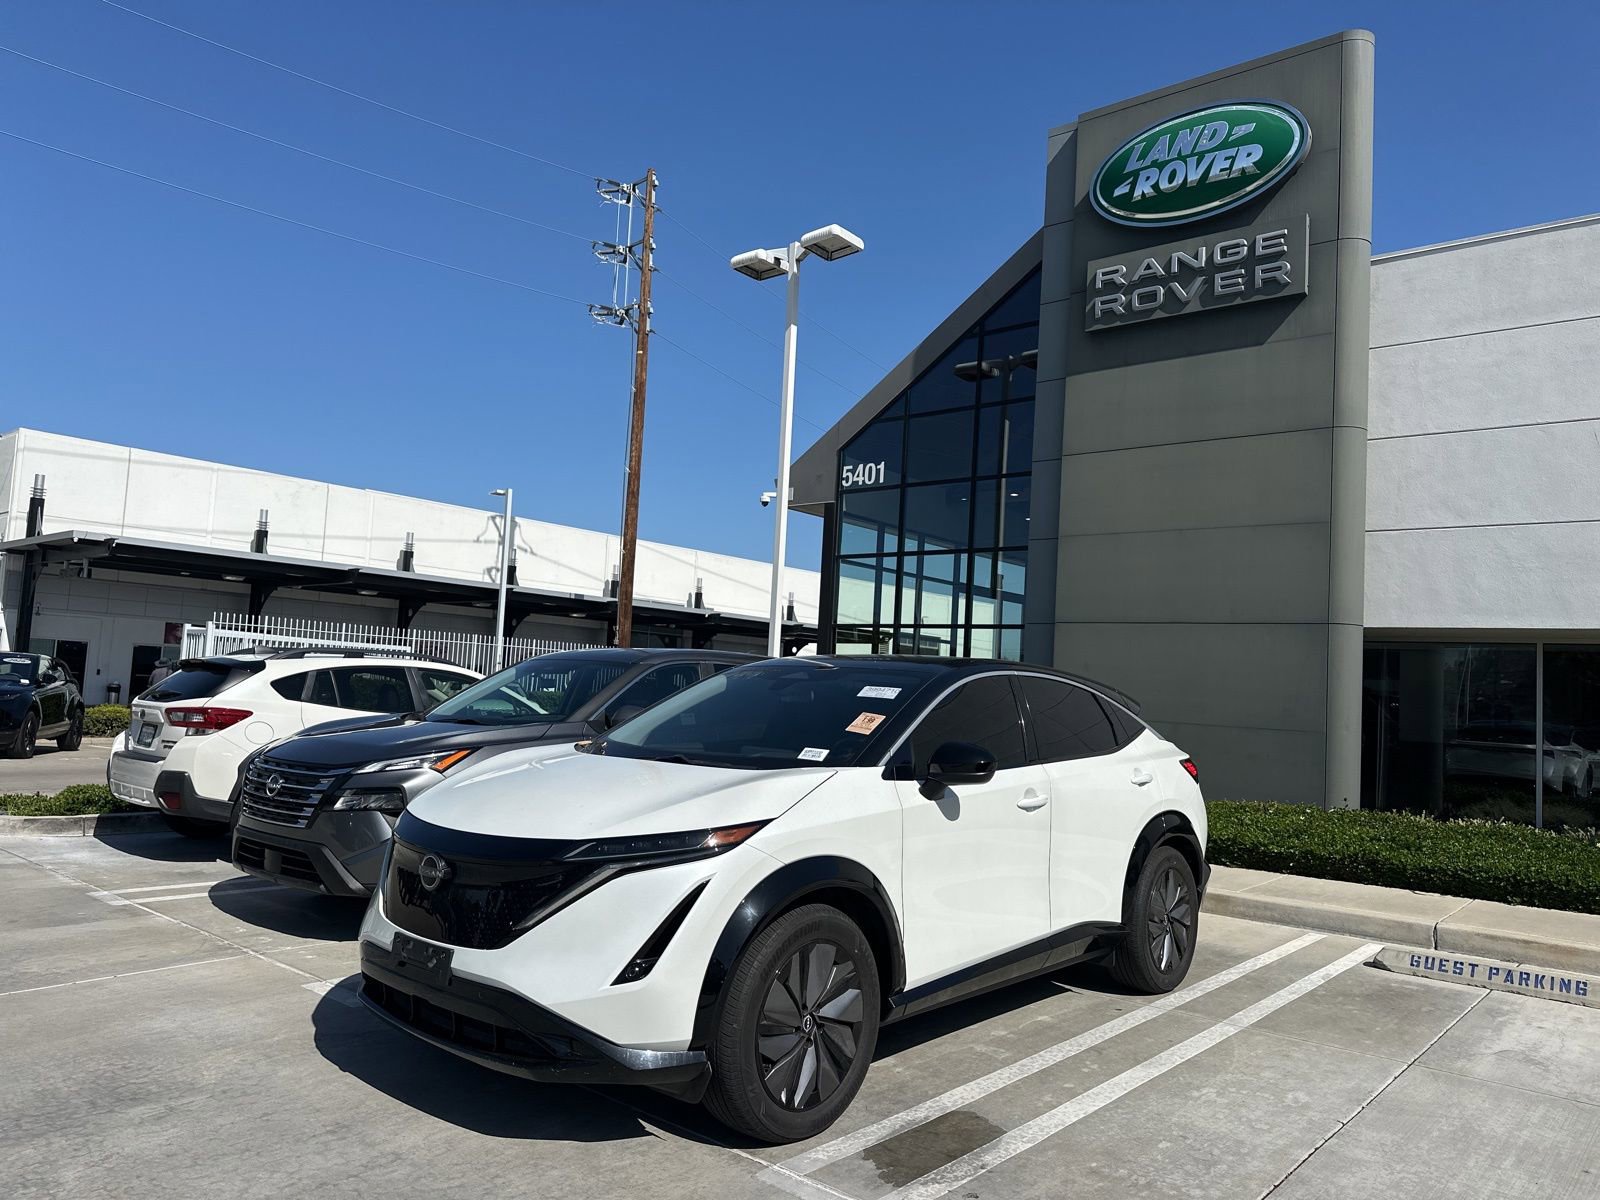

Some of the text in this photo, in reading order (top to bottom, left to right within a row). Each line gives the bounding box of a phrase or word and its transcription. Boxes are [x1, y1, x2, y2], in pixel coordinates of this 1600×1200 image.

[1123, 120, 1229, 174] LAND
[1131, 143, 1264, 202] ROVER
[1095, 228, 1288, 290] RANGE
[1094, 260, 1292, 320] ROVER
[842, 461, 885, 487] 5401
[1410, 954, 1589, 997] GUEST PARKING
